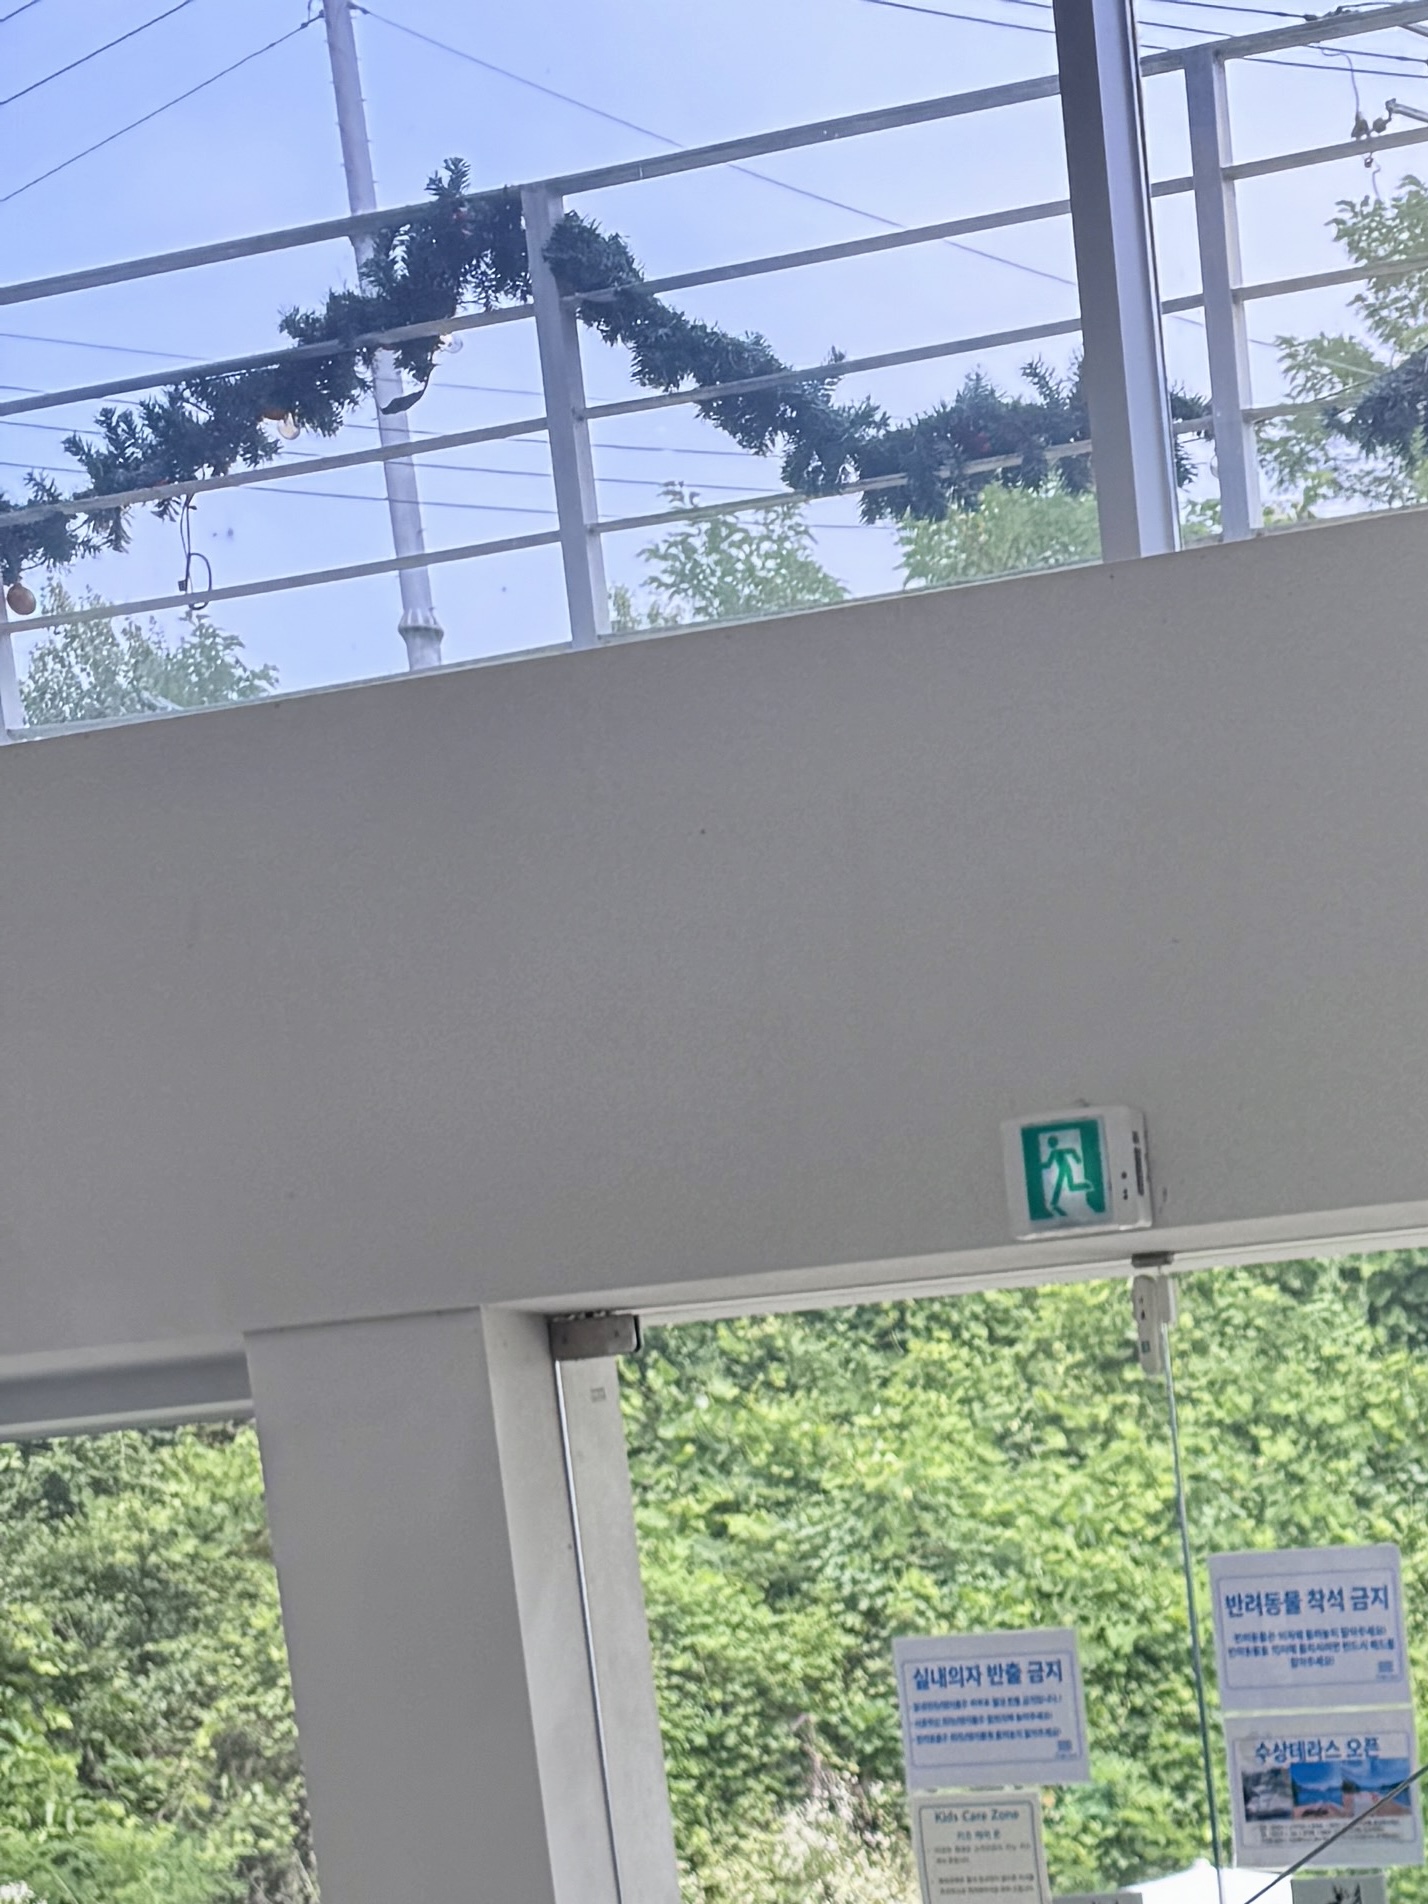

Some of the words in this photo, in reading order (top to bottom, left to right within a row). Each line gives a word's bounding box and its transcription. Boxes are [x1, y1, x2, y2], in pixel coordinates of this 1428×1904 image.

[1225, 1590, 1301, 1618] 반려동물
[1308, 1586, 1345, 1613] 착석
[1350, 1584, 1390, 1612] 금지
[913, 1663, 982, 1691] 실내의자
[986, 1661, 1022, 1687] 반출
[1027, 1659, 1063, 1684] 금지
[1346, 1736, 1380, 1759] 오픈
